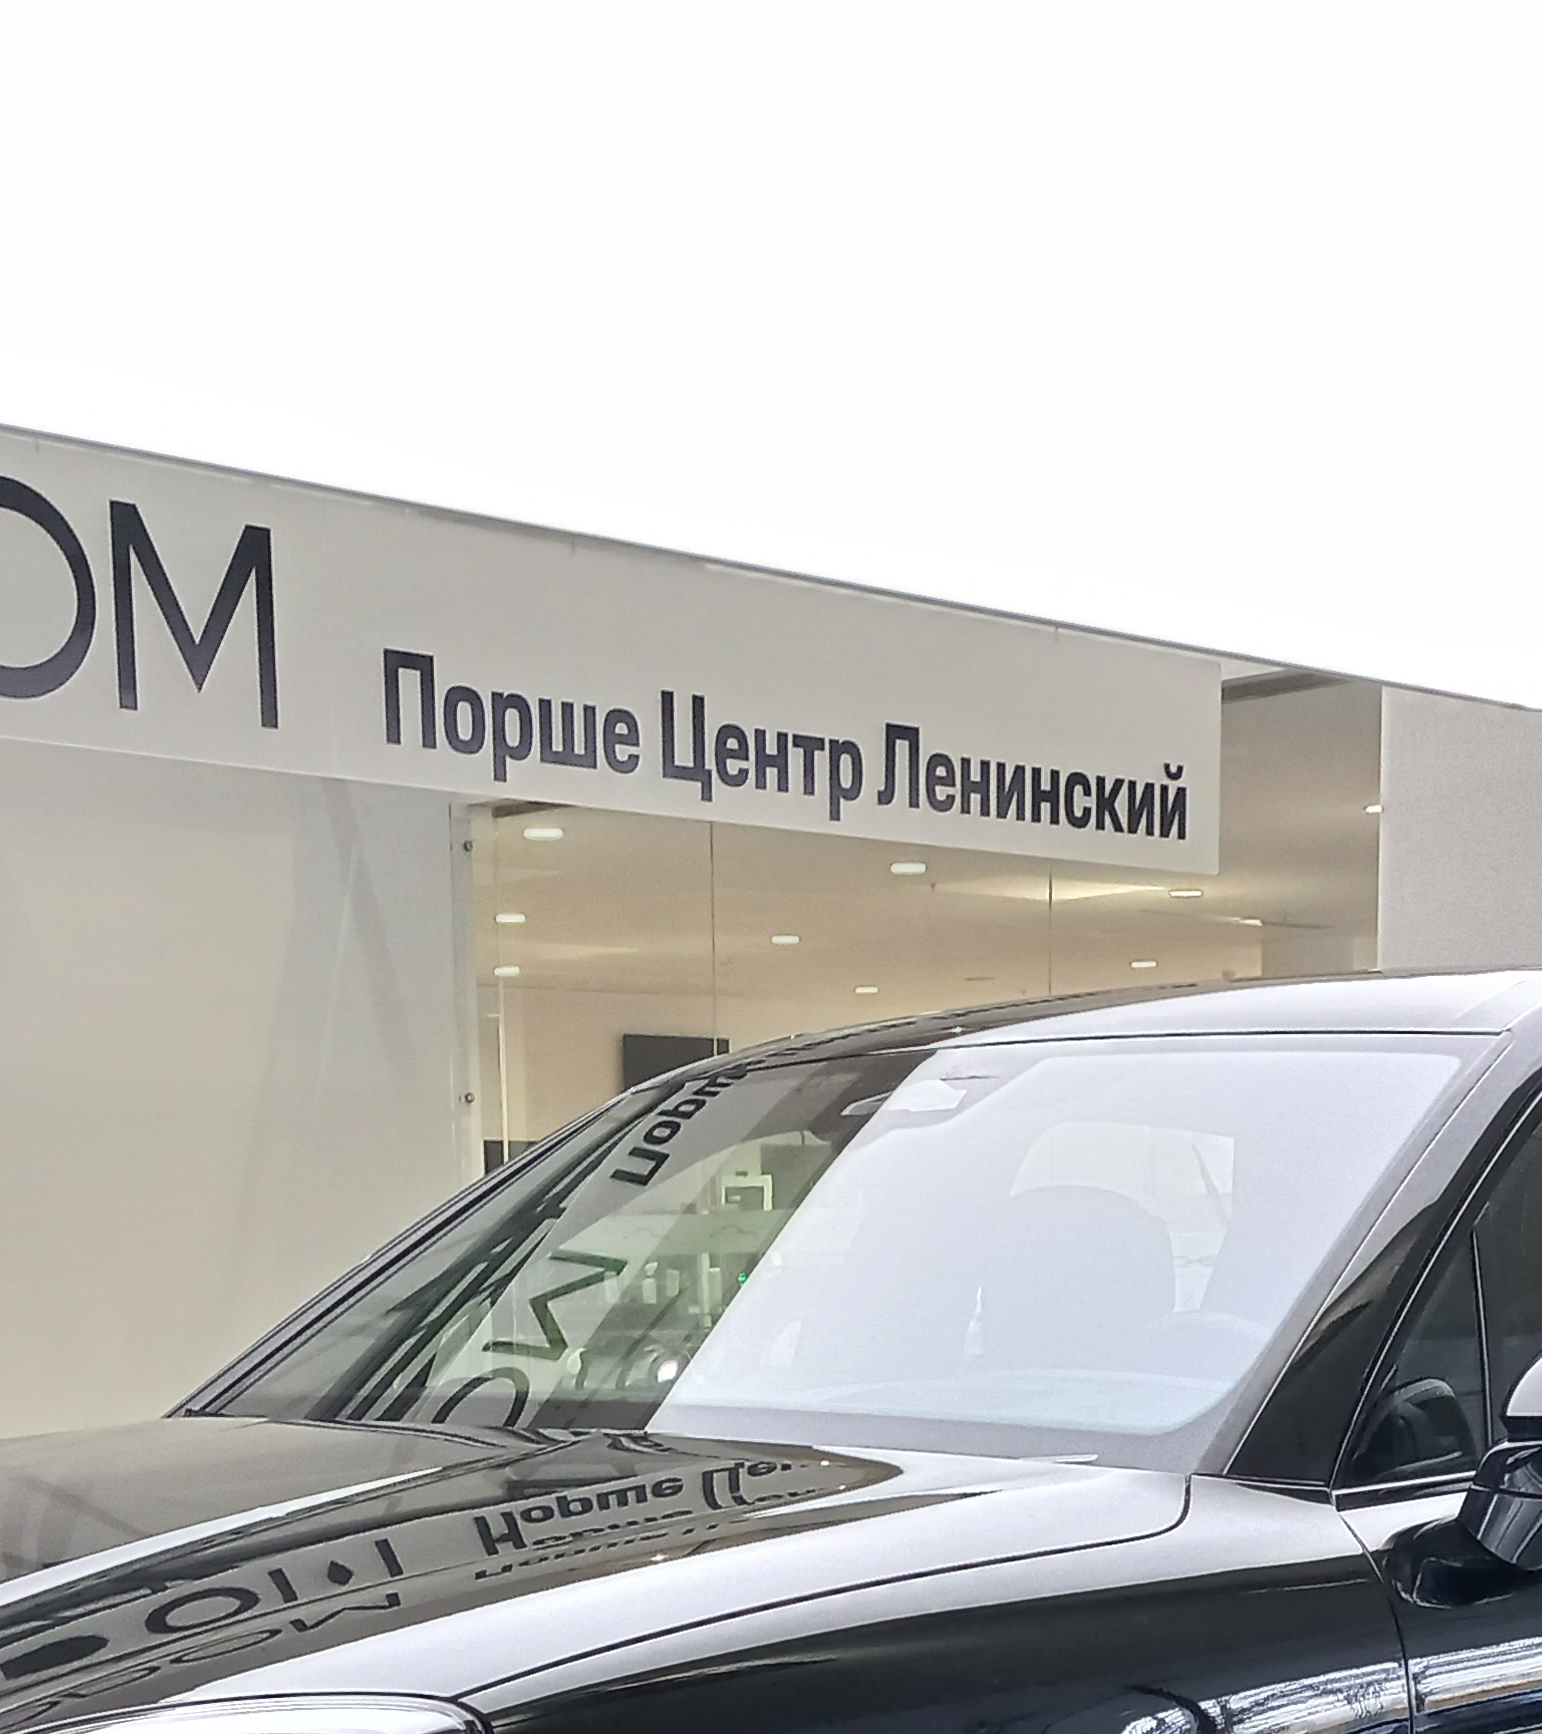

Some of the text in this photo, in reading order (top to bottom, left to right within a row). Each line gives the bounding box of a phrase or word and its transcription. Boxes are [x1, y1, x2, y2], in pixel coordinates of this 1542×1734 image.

[381, 647, 1189, 840] Порше Центр Ленинский
